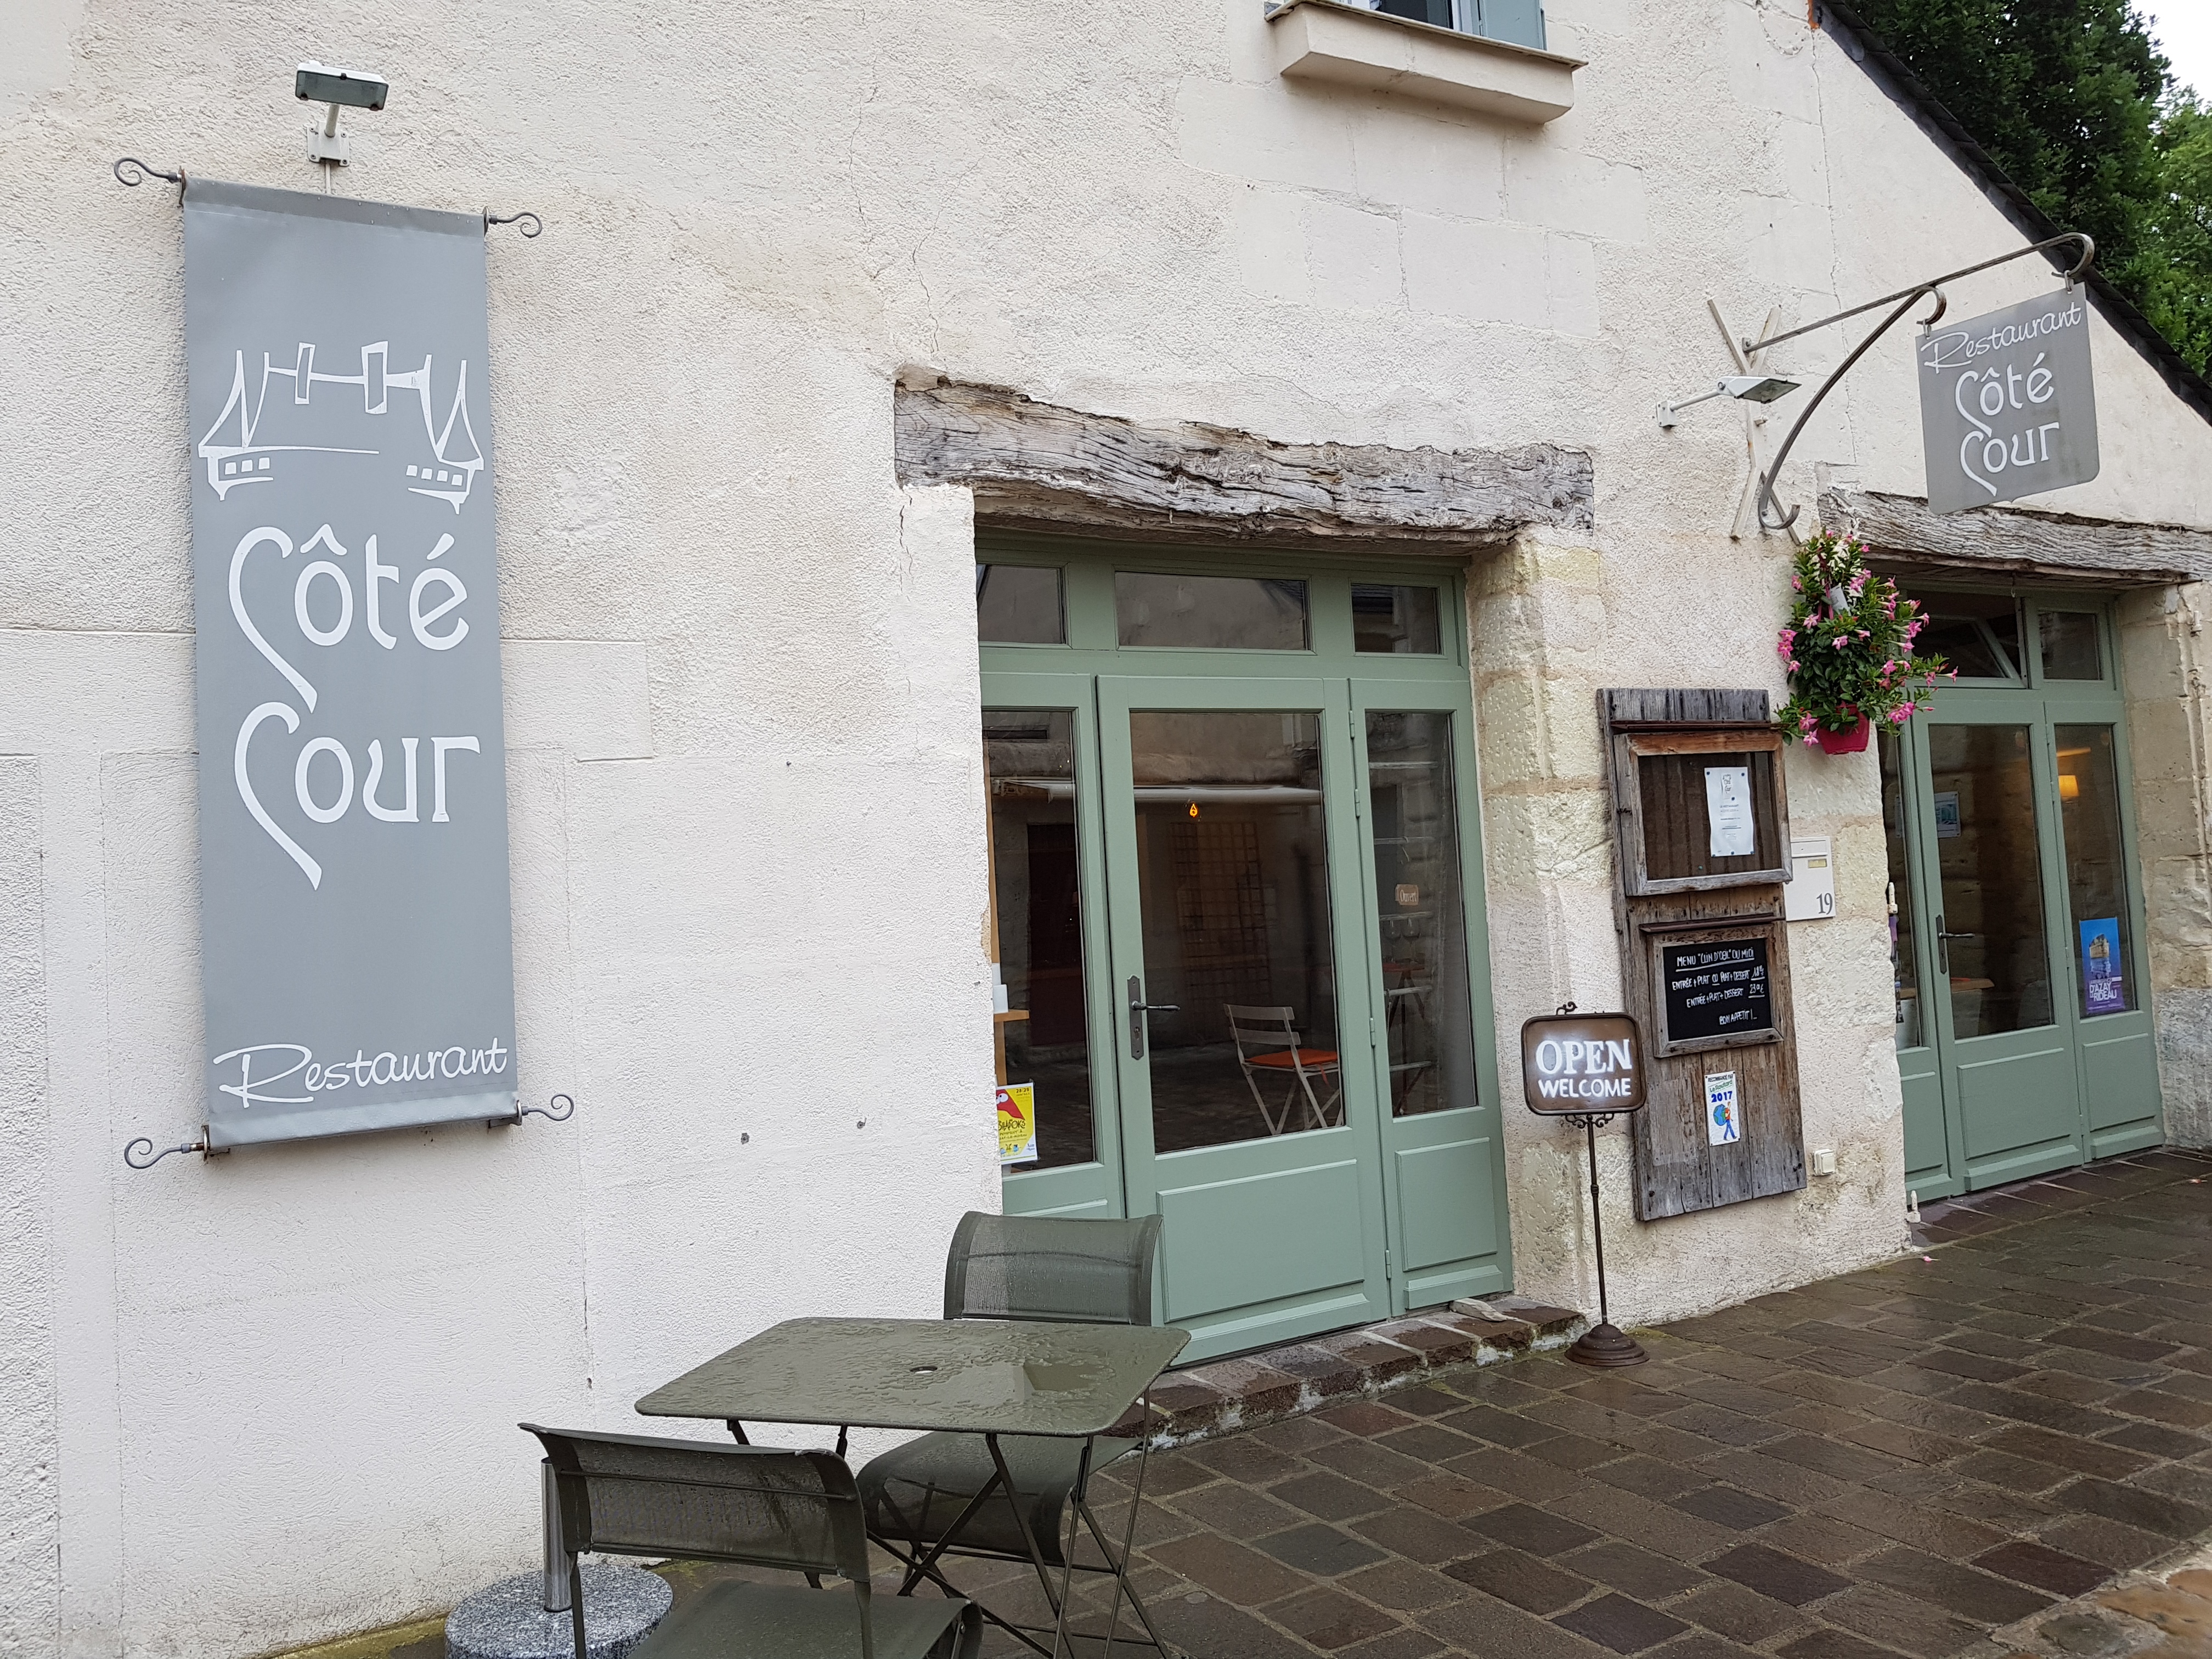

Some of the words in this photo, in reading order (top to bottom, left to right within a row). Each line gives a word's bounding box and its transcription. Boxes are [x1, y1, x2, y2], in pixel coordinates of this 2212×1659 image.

[1921, 302, 2081, 374] Restaurant
[1955, 352, 2055, 438] Côté
[1960, 422, 2059, 497] Cour
[229, 523, 470, 714] Côté
[234, 702, 481, 891] Cour
[1816, 893, 1833, 915] 19
[1677, 955, 1696, 967] MENU
[2094, 989, 2118, 1002] RIDEAU
[1719, 1014, 1730, 1025] BON
[213, 1037, 508, 1109] Restaurant
[1536, 1039, 1633, 1075] OPEN
[1538, 1078, 1632, 1098] WELCOME
[1711, 1091, 1733, 1103] 2017
